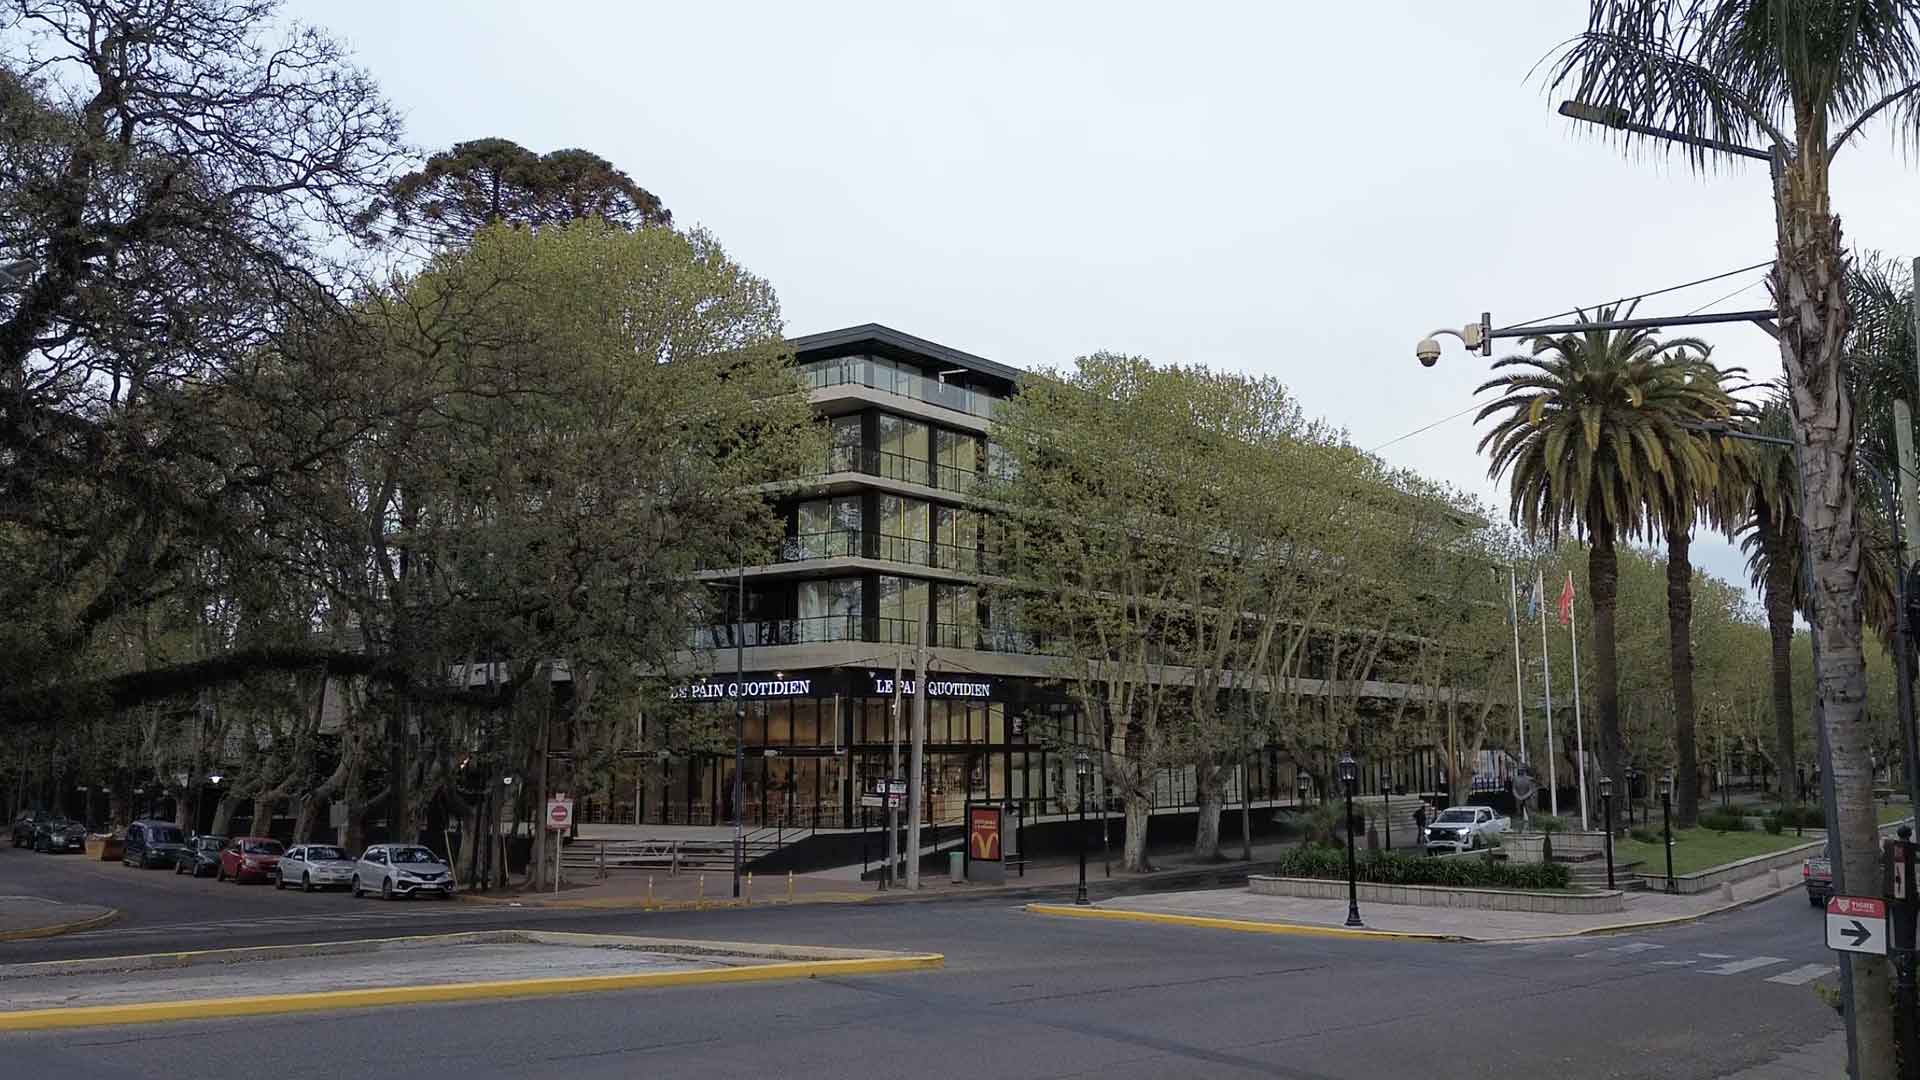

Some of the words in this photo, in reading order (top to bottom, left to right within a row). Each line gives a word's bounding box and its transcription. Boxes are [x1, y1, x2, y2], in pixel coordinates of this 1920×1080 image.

[691, 683, 724, 698] PAIN
[728, 680, 810, 697] QUOTIDIEN
[876, 679, 893, 693] LE
[928, 681, 990, 697] QUOTIDIEN
